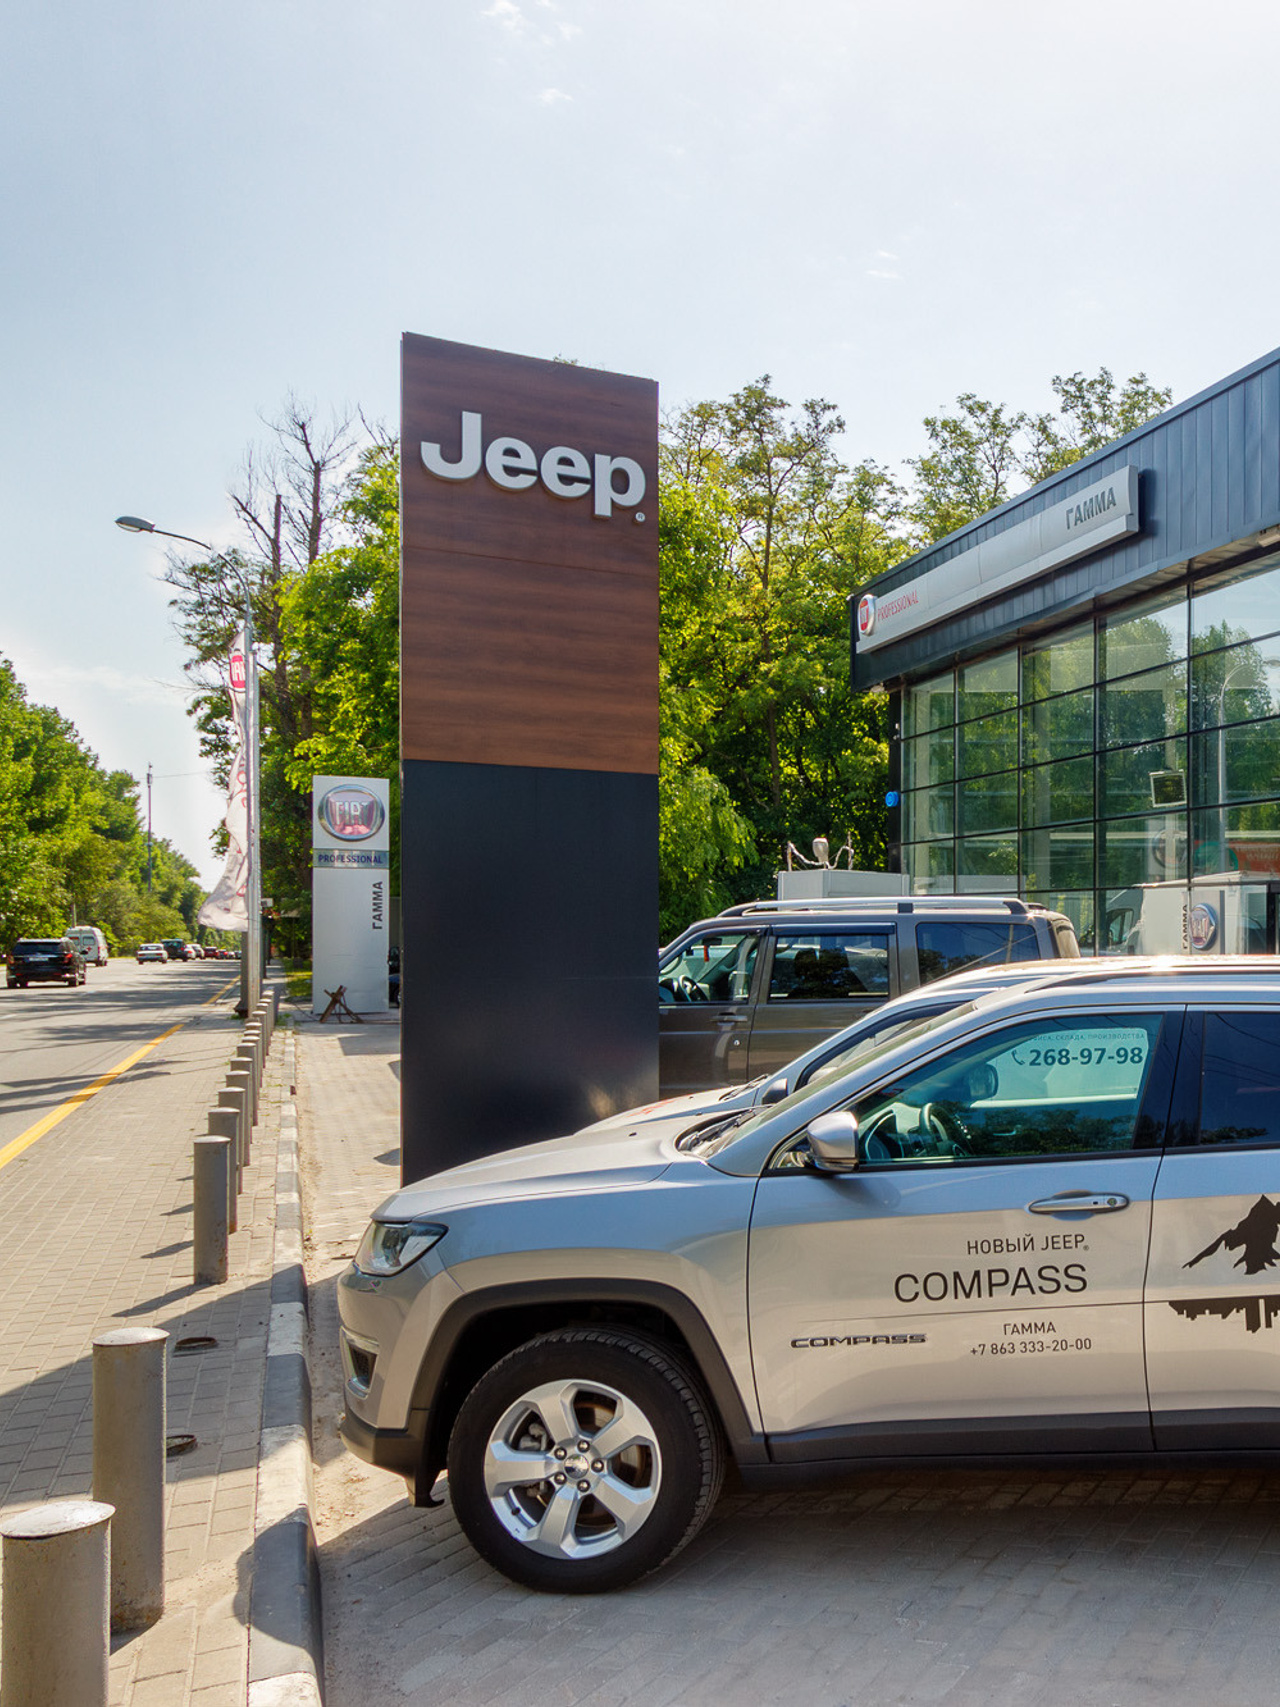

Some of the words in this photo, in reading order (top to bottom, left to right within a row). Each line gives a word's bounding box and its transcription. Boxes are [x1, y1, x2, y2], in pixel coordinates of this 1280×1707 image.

[420, 411, 646, 517] Jeep
[1065, 487, 1116, 530] ГАММА
[877, 589, 919, 621] PROFESSIONAL
[335, 801, 371, 825] FIAT
[318, 854, 383, 864] PROFESSIONAL
[371, 881, 383, 930] ГАММА
[1028, 1047, 1143, 1066] 268-97-98
[967, 1234, 1035, 1255] НОВЫЙ
[894, 1264, 1088, 1303] COMPASS
[1003, 1322, 1056, 1335] ГАММА
[790, 1333, 927, 1348] COMPASS
[970, 1341, 986, 1355] +7
[990, 1340, 1016, 1354] 863
[1020, 1338, 1092, 1353] 333-20-00
